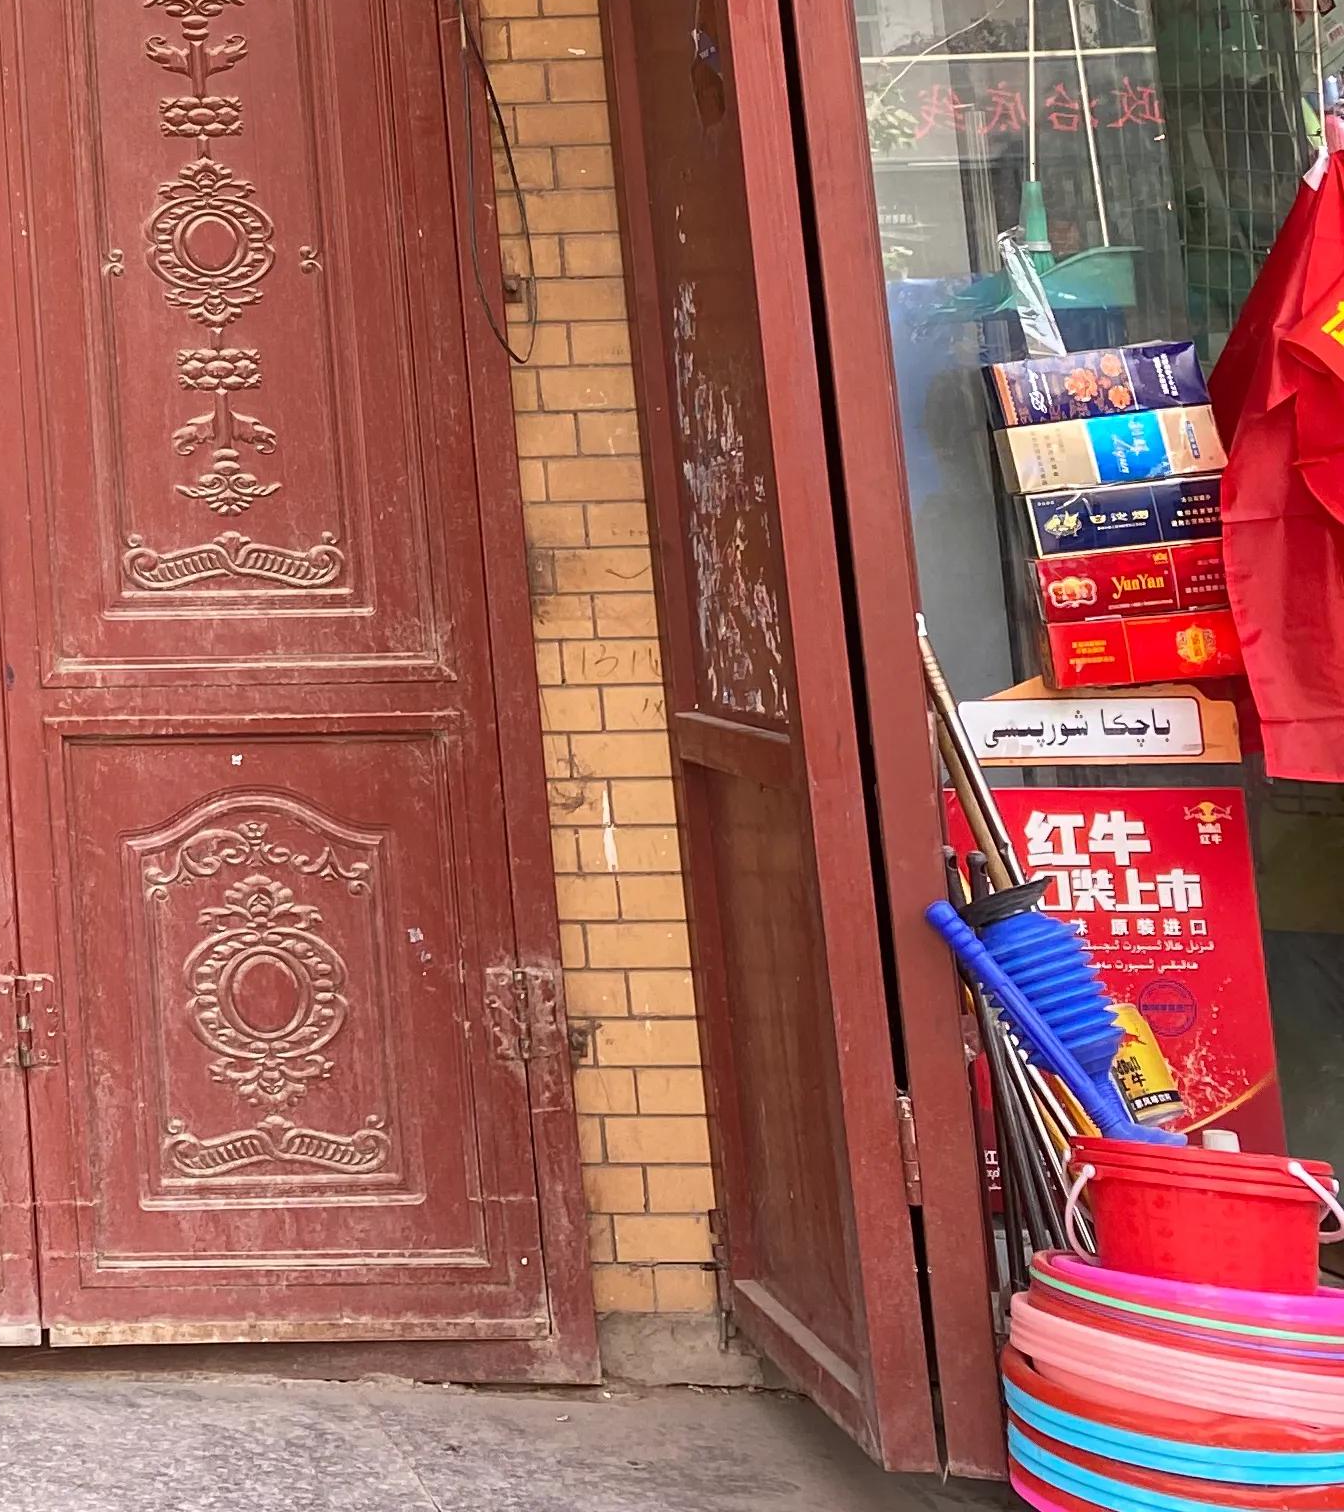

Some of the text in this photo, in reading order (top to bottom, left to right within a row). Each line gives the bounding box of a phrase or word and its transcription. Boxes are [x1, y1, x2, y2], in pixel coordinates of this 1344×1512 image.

[1110, 573, 1165, 600] YunYan
[1100, 707, 1172, 748] باچكا
[1024, 810, 1153, 867] 红牛
[1110, 918, 1209, 937] 原装进口
